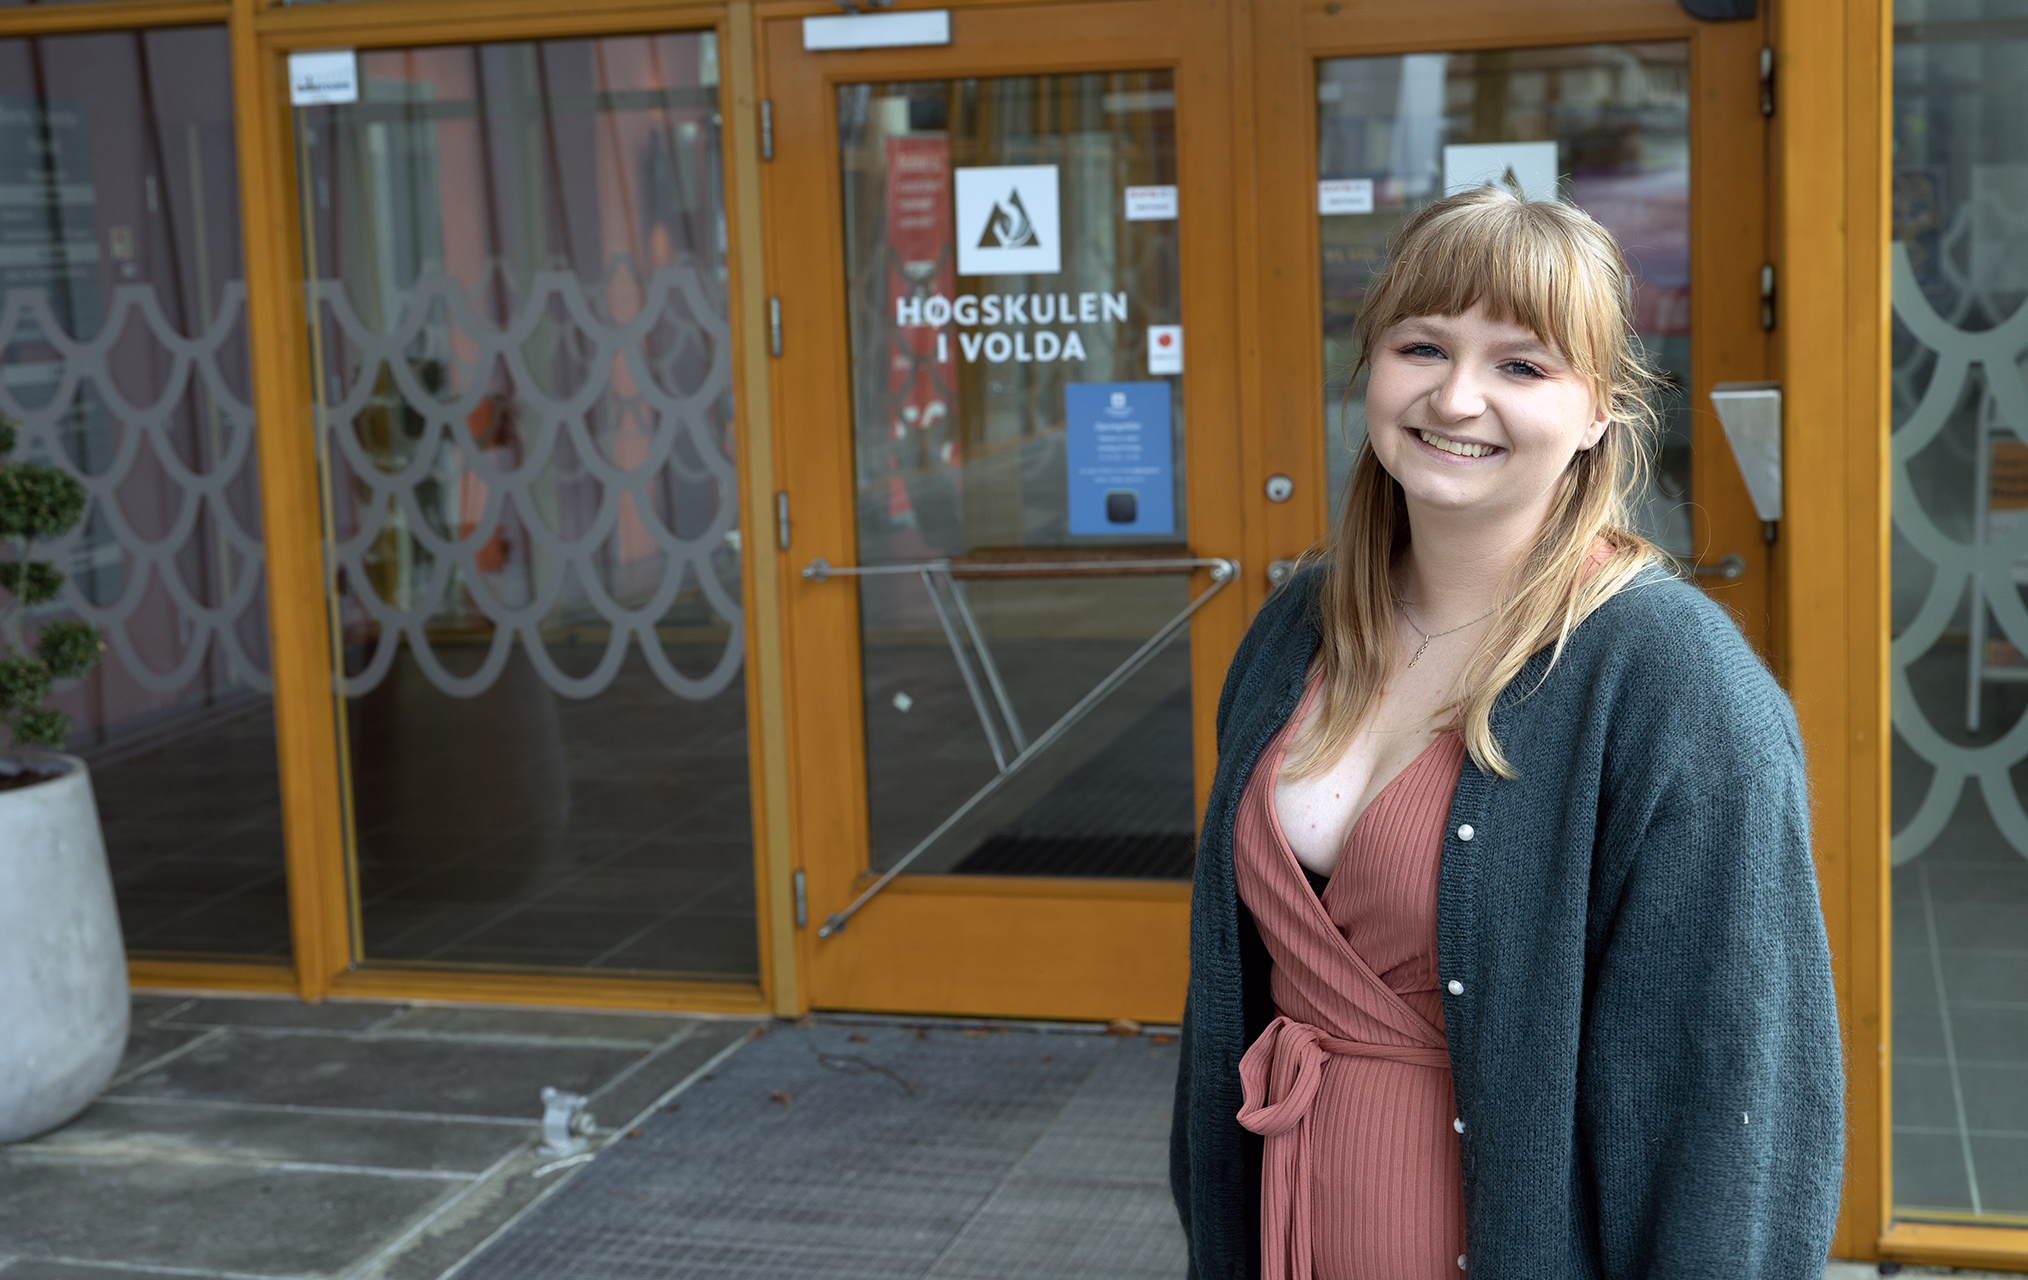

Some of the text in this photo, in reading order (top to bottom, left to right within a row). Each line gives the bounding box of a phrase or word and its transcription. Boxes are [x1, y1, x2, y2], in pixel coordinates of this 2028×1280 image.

[896, 292, 1128, 329] HØGSKULEN
[937, 332, 948, 363] I
[958, 331, 1087, 363] VOLDA
